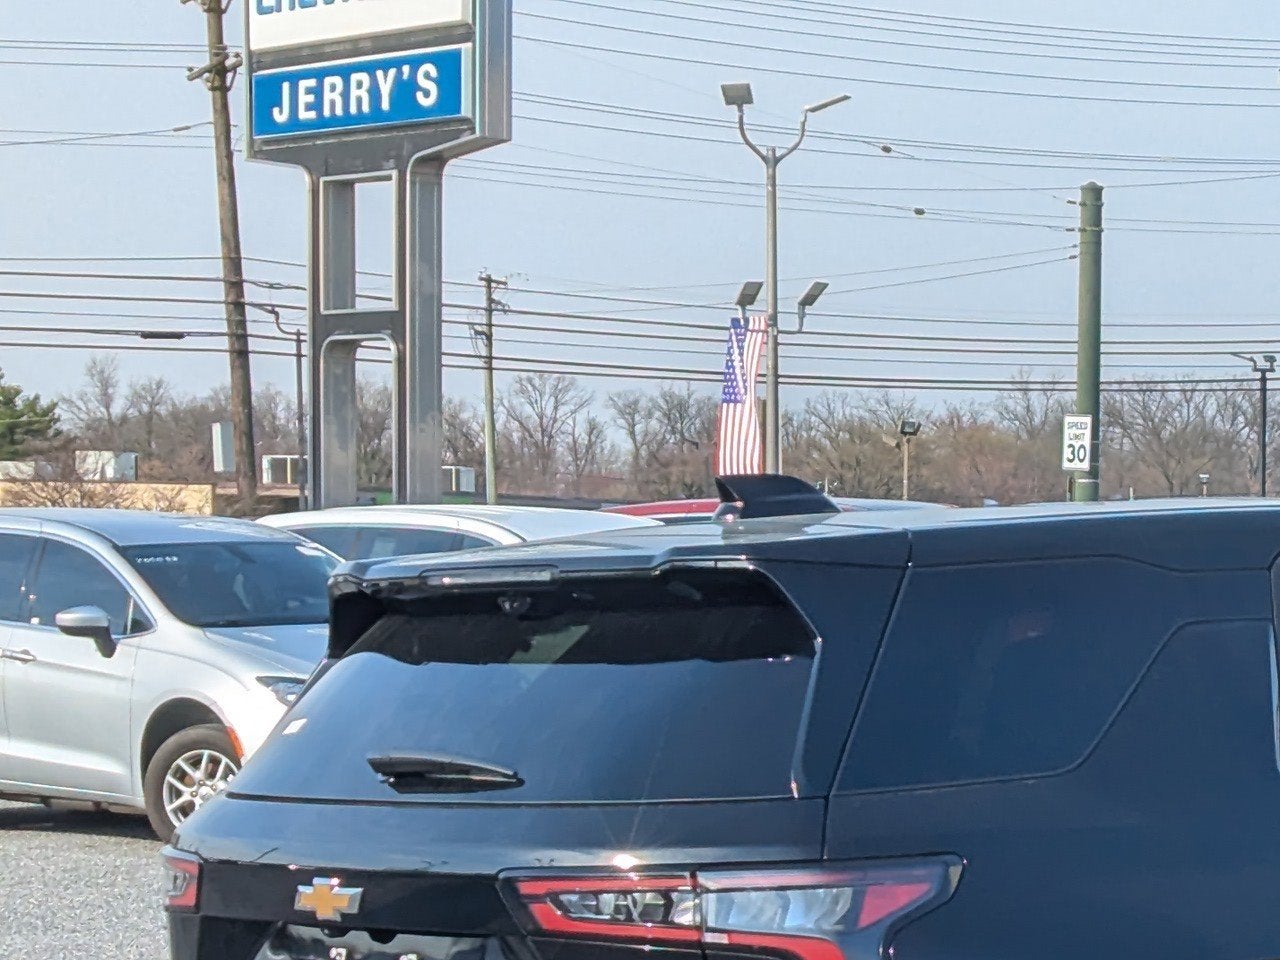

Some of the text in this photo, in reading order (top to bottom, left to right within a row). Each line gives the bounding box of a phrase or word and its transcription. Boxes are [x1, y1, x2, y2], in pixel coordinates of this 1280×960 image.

[272, 63, 438, 123] JERRY'S
[1067, 421, 1088, 430] SPEED
[1068, 432, 1085, 441] LIMIT
[1066, 443, 1087, 463] 30
